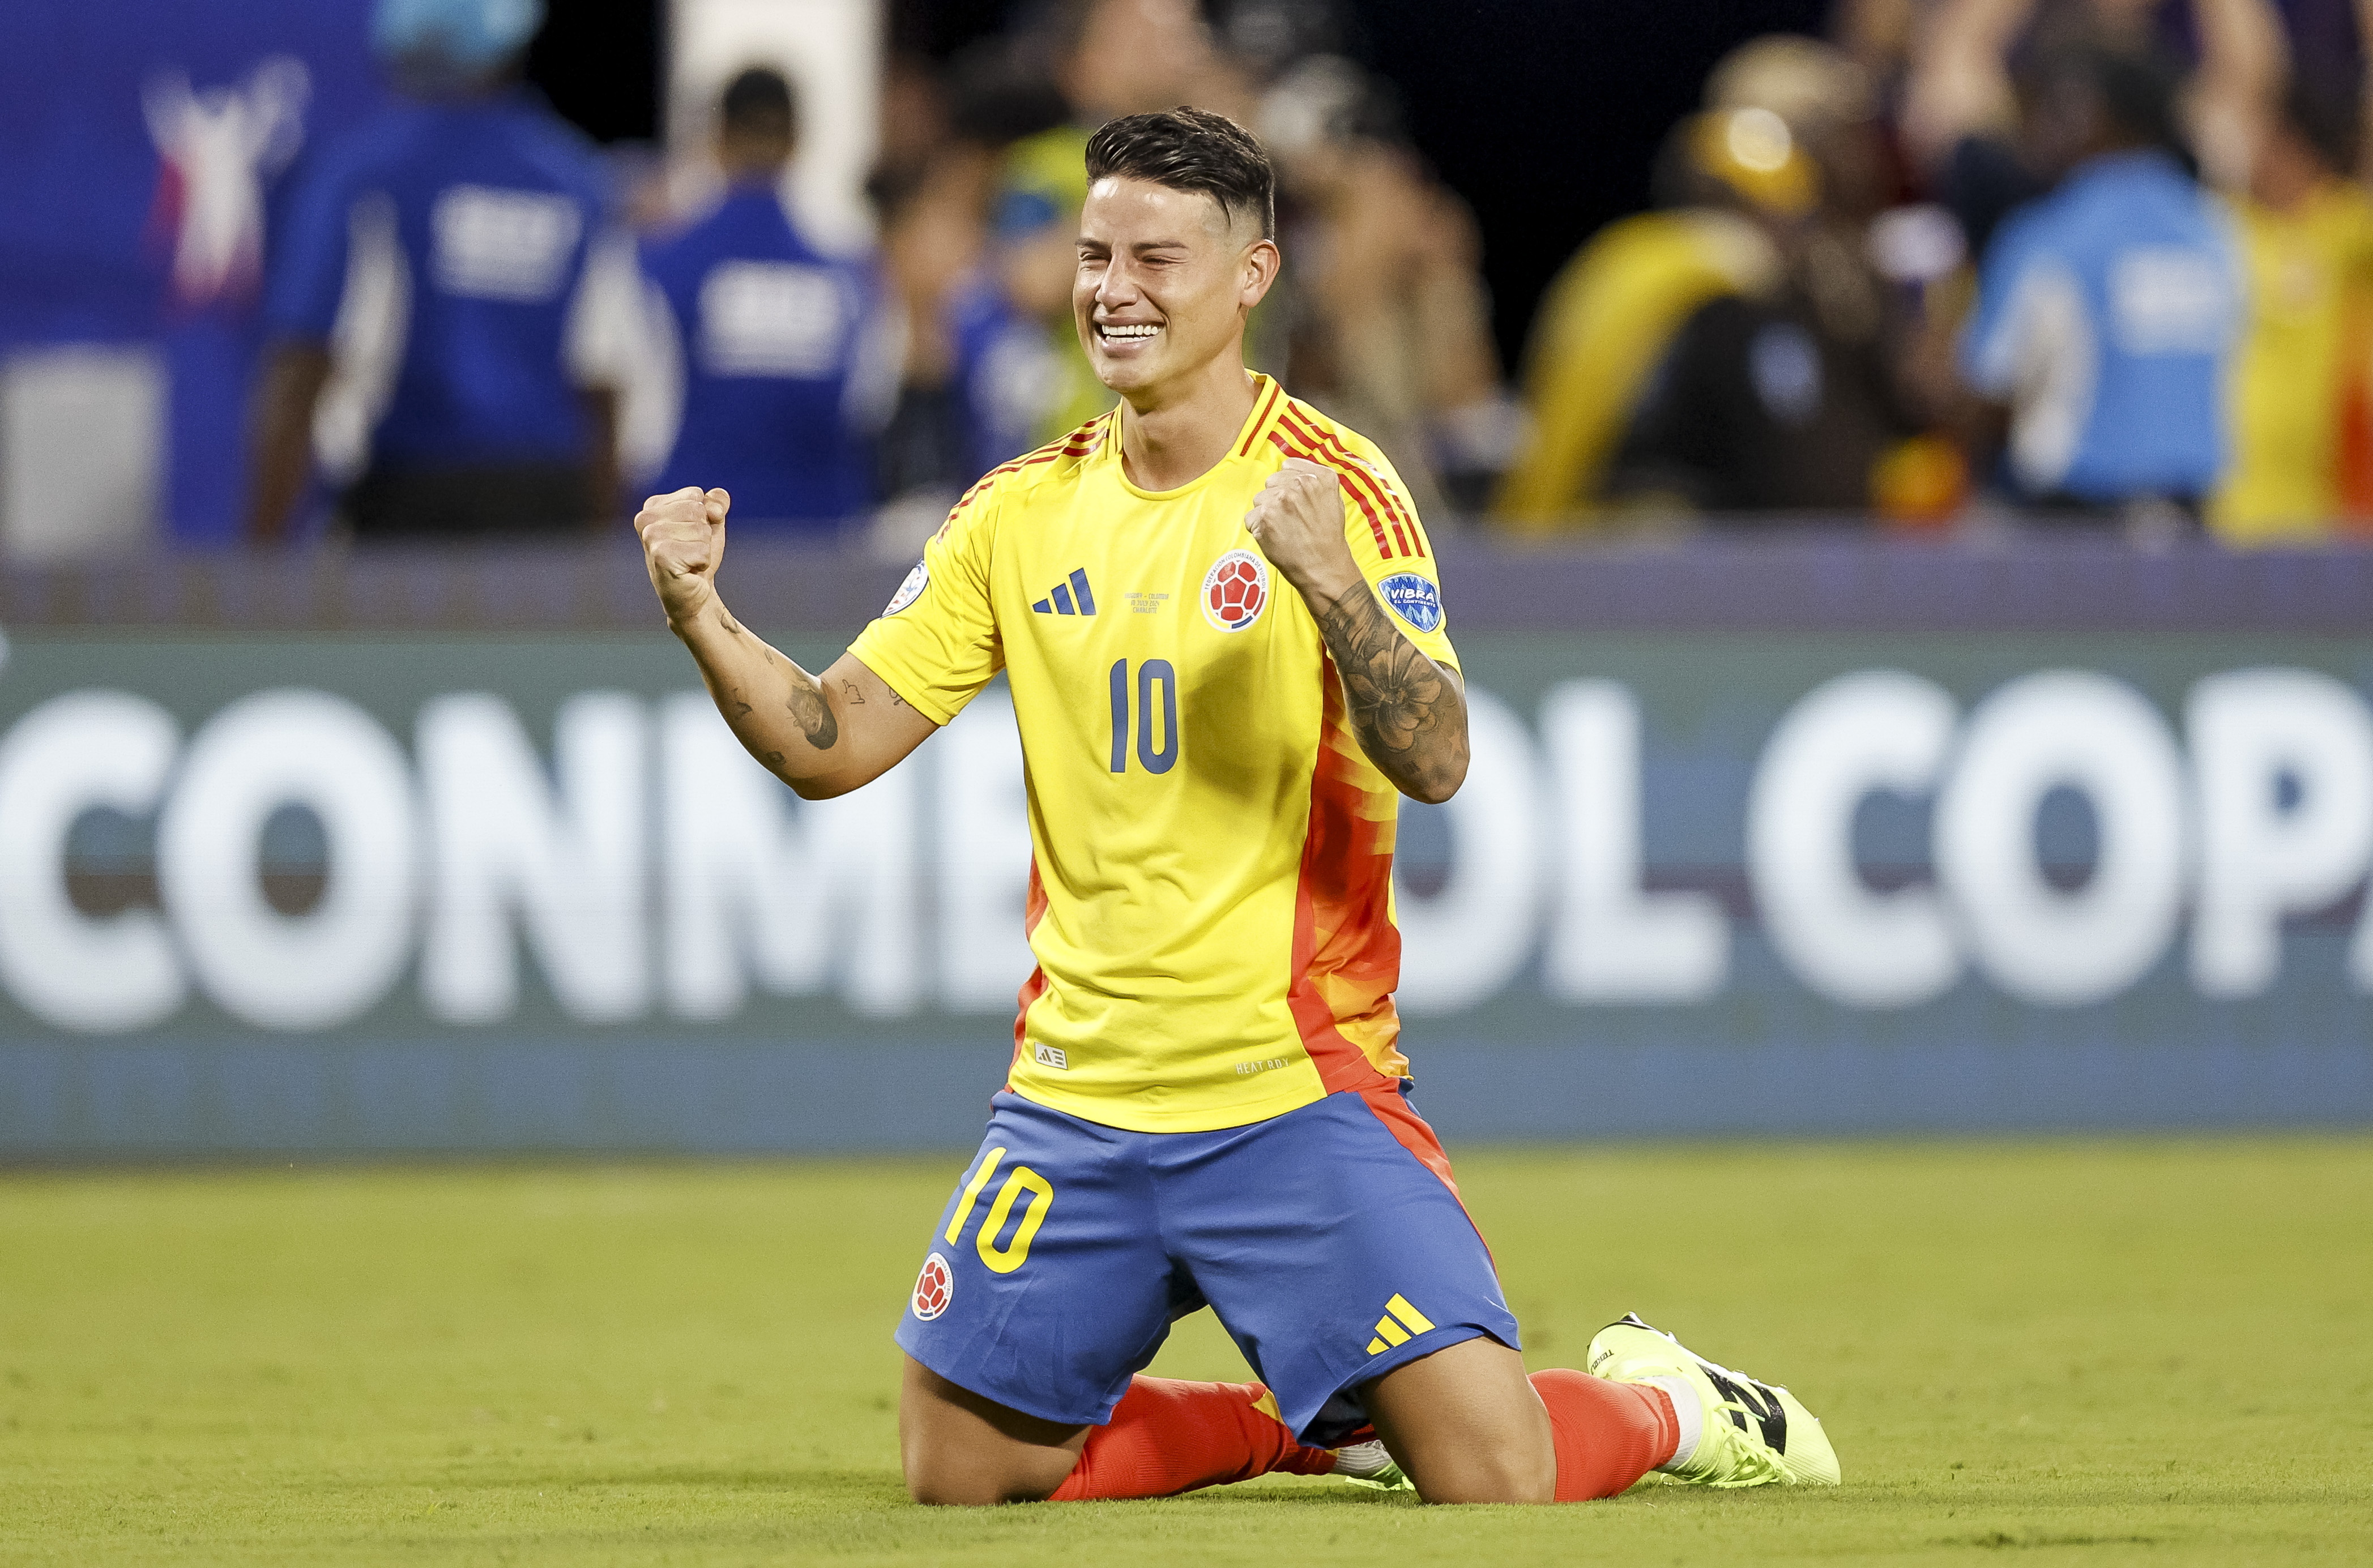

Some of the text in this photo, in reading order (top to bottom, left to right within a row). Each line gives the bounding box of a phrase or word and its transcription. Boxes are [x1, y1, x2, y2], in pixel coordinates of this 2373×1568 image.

[1226, 553, 1256, 563] COLOMBIANA
[1391, 588, 1435, 603] VIBRA
[1109, 657, 1179, 775] 10
[0, 667, 2373, 1033] CONMEOL COP
[944, 1147, 1055, 1274] 10
